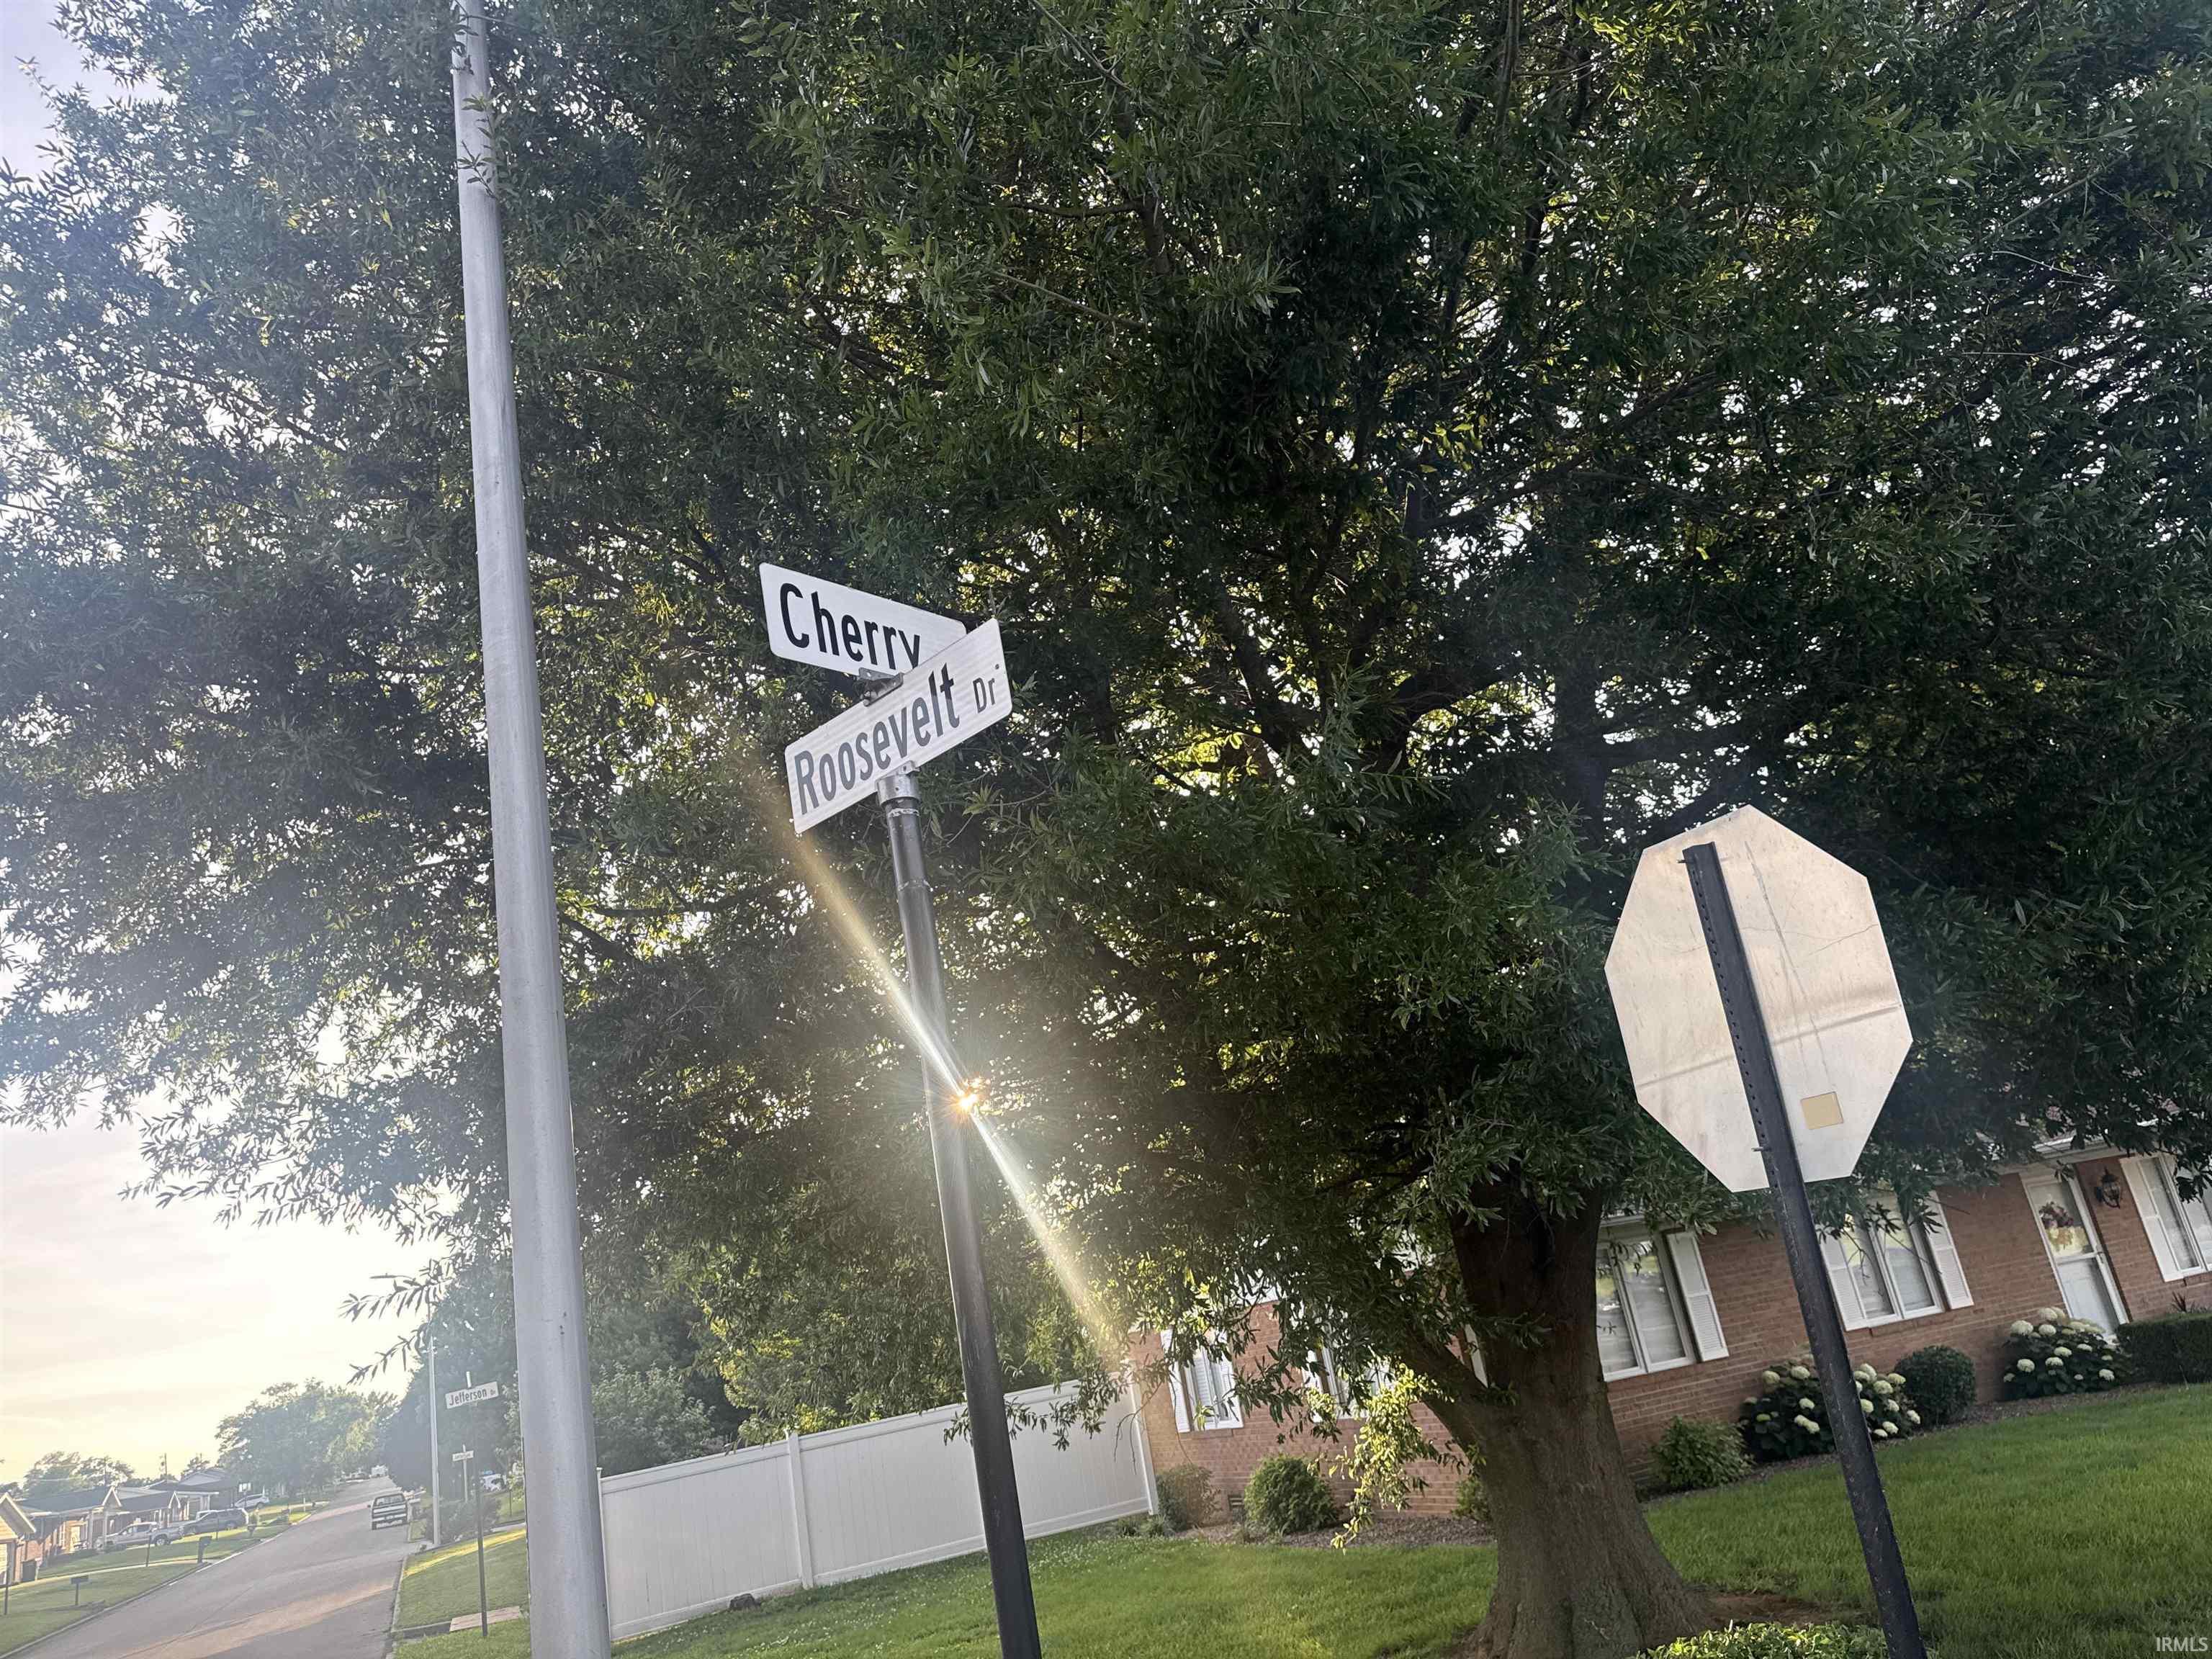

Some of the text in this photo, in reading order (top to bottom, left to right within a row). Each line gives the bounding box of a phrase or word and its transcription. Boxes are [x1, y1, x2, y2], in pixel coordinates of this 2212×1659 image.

[780, 583, 920, 670] Cherry
[794, 663, 995, 815] Roosevelt Dr
[449, 1389, 487, 1406] Jefferson
